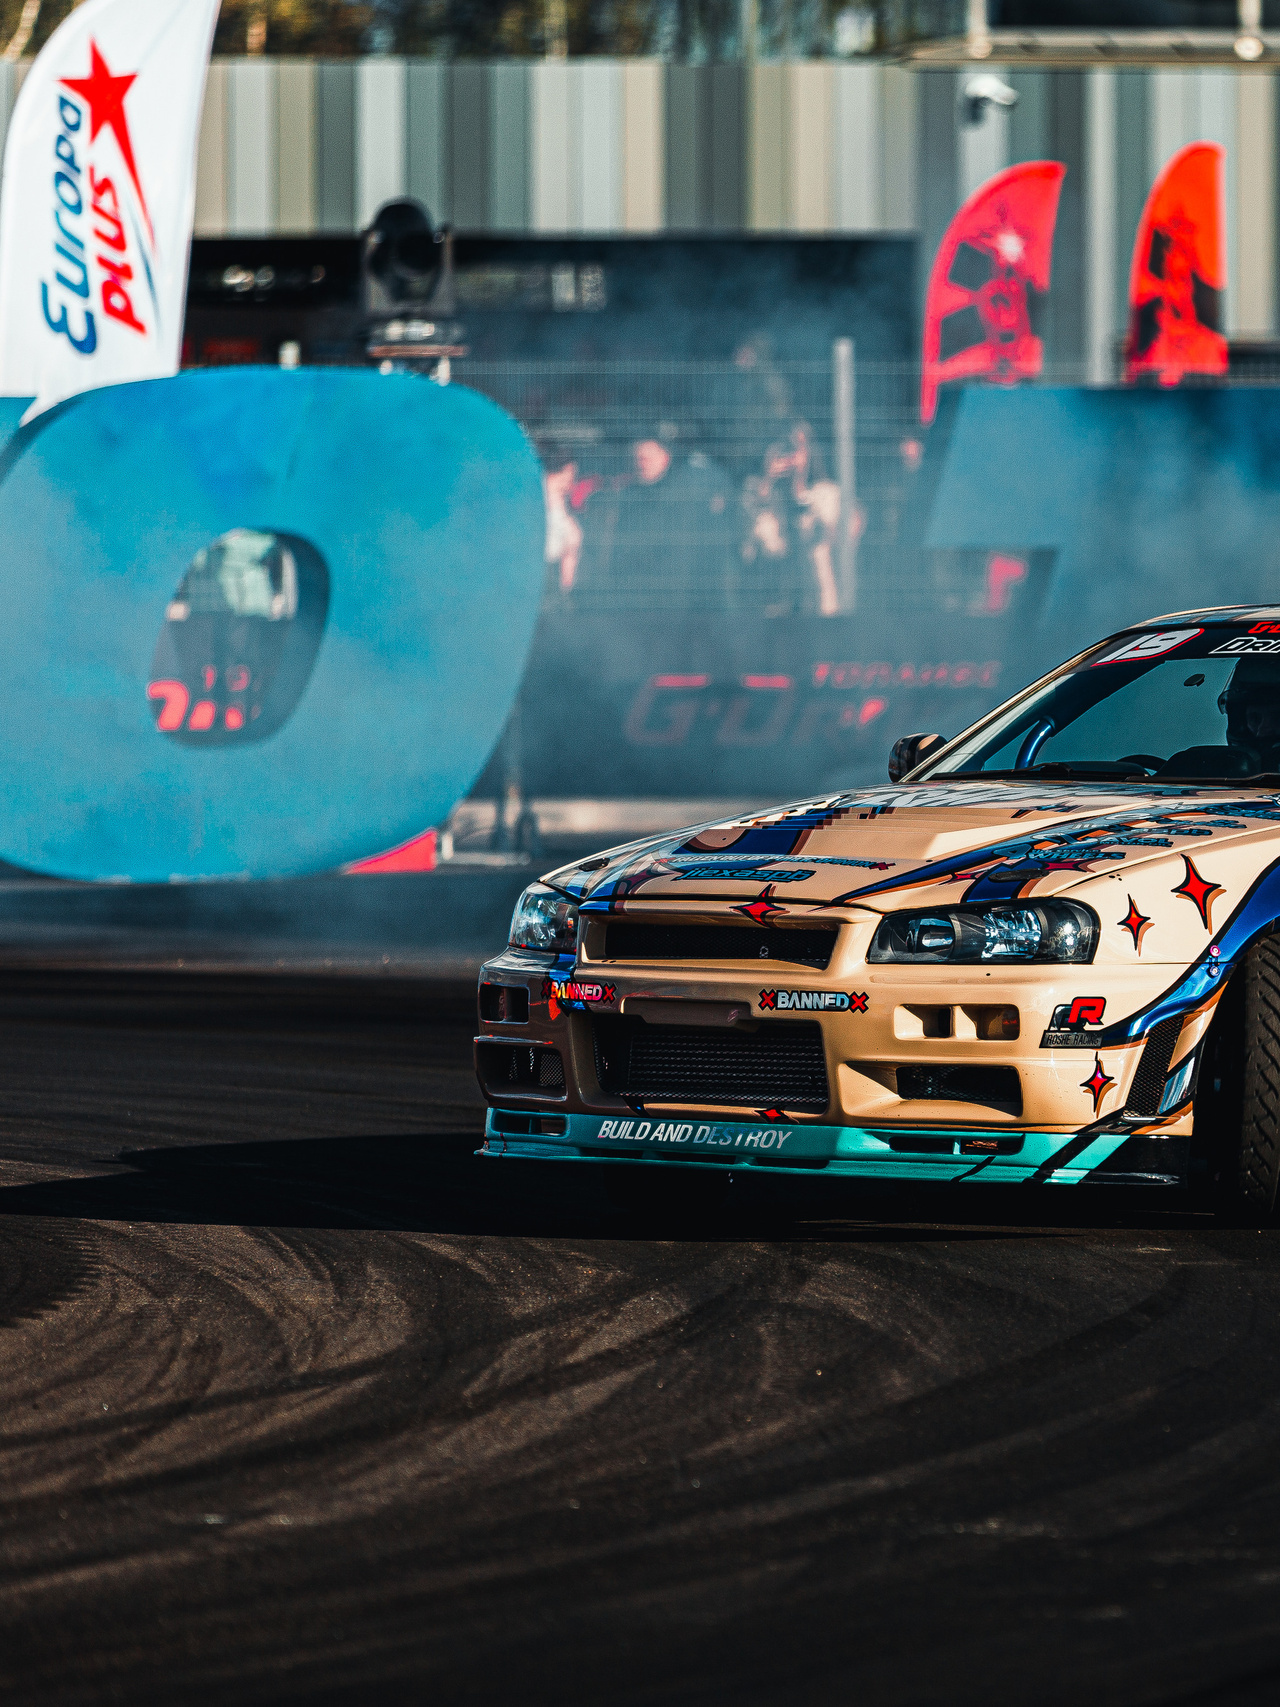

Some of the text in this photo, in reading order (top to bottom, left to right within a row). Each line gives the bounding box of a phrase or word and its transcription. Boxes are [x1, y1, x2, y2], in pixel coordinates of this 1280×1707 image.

[41, 95, 97, 356] Europa
[88, 165, 147, 336] plus
[1100, 628, 1202, 664] 19
[1027, 851, 1126, 860] WHEELS
[597, 1120, 793, 1149] BUILD AND DESTROY
